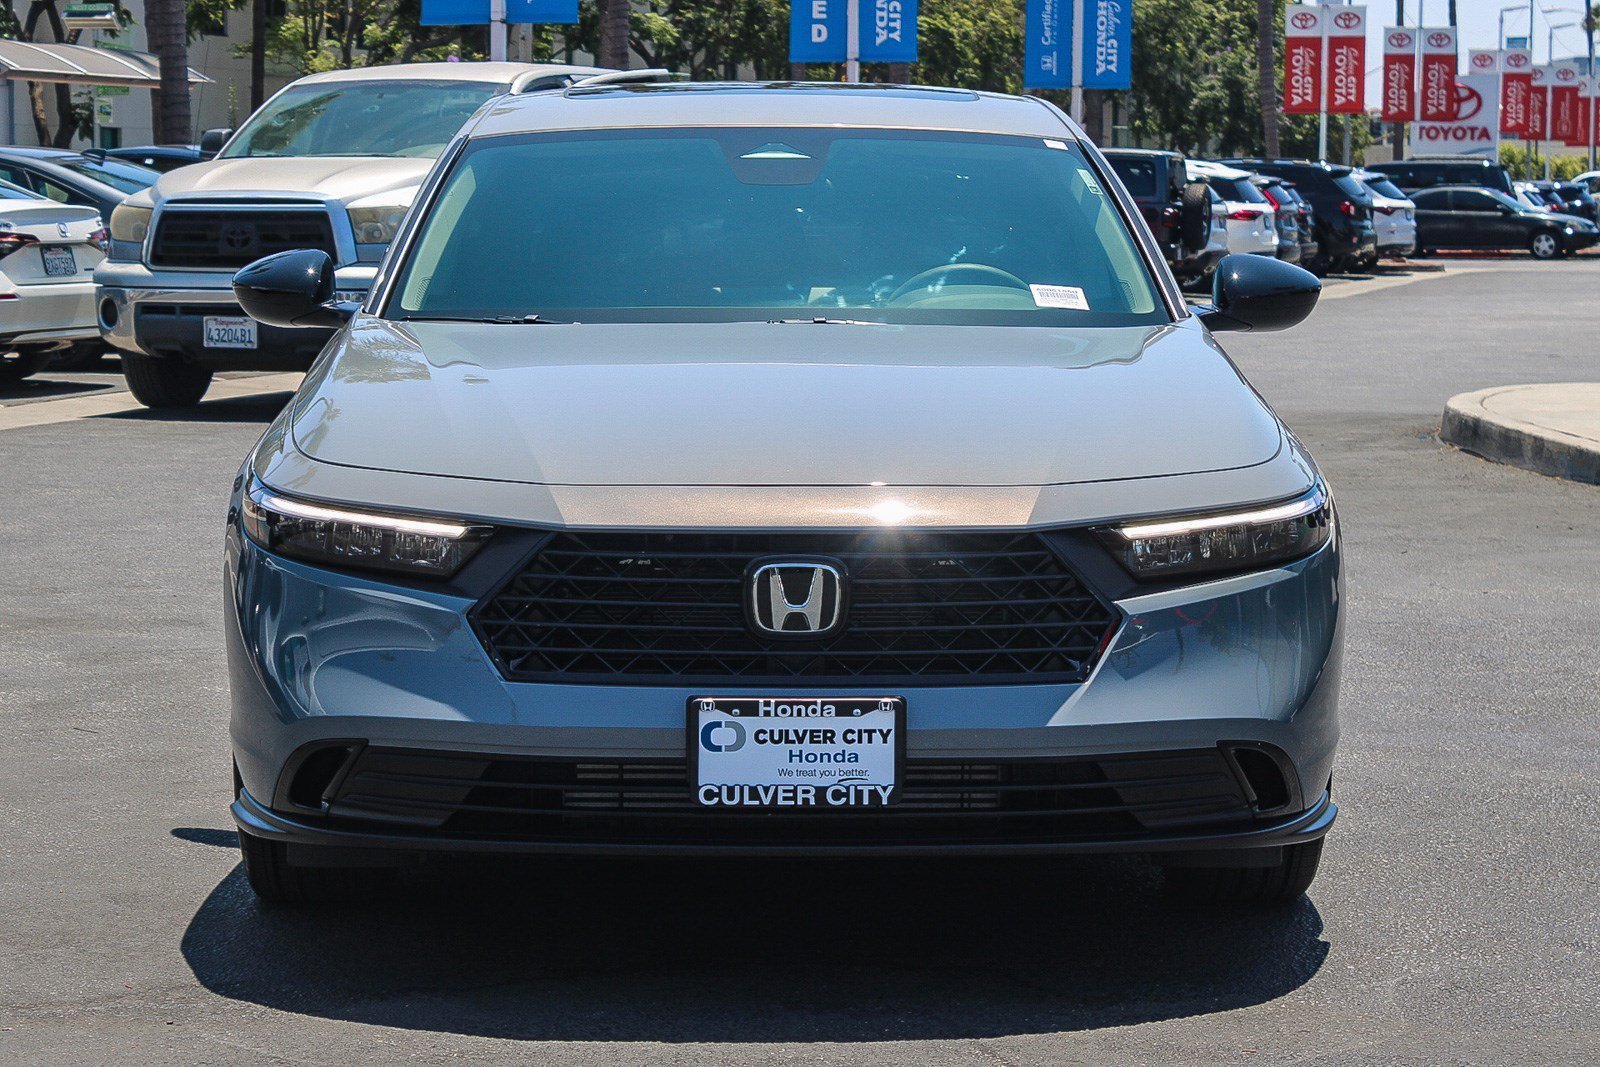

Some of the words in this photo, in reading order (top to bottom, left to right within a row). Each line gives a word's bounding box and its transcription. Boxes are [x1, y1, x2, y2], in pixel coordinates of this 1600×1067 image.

[888, 1, 901, 43] CITY
[1095, 0, 1108, 76] HONDA
[1107, 38, 1118, 73] CITY
[1291, 46, 1304, 106] TOYOTA
[1334, 46, 1347, 106] TOYOTA
[1387, 61, 1400, 115] TOYOTA
[1427, 61, 1439, 115] TOYOTA
[1418, 126, 1492, 141] TOYOTA
[207, 328, 253, 344] 43204B1
[758, 699, 836, 718] Honda
[753, 728, 837, 745] CULVER
[842, 728, 893, 745] CITY
[788, 749, 860, 764] Honda
[777, 768, 794, 777] We
[796, 768, 817, 777] treat
[818, 769, 837, 779] you
[838, 768, 870, 777] better.
[698, 784, 817, 806] CULVER
[825, 784, 895, 806] CITY
